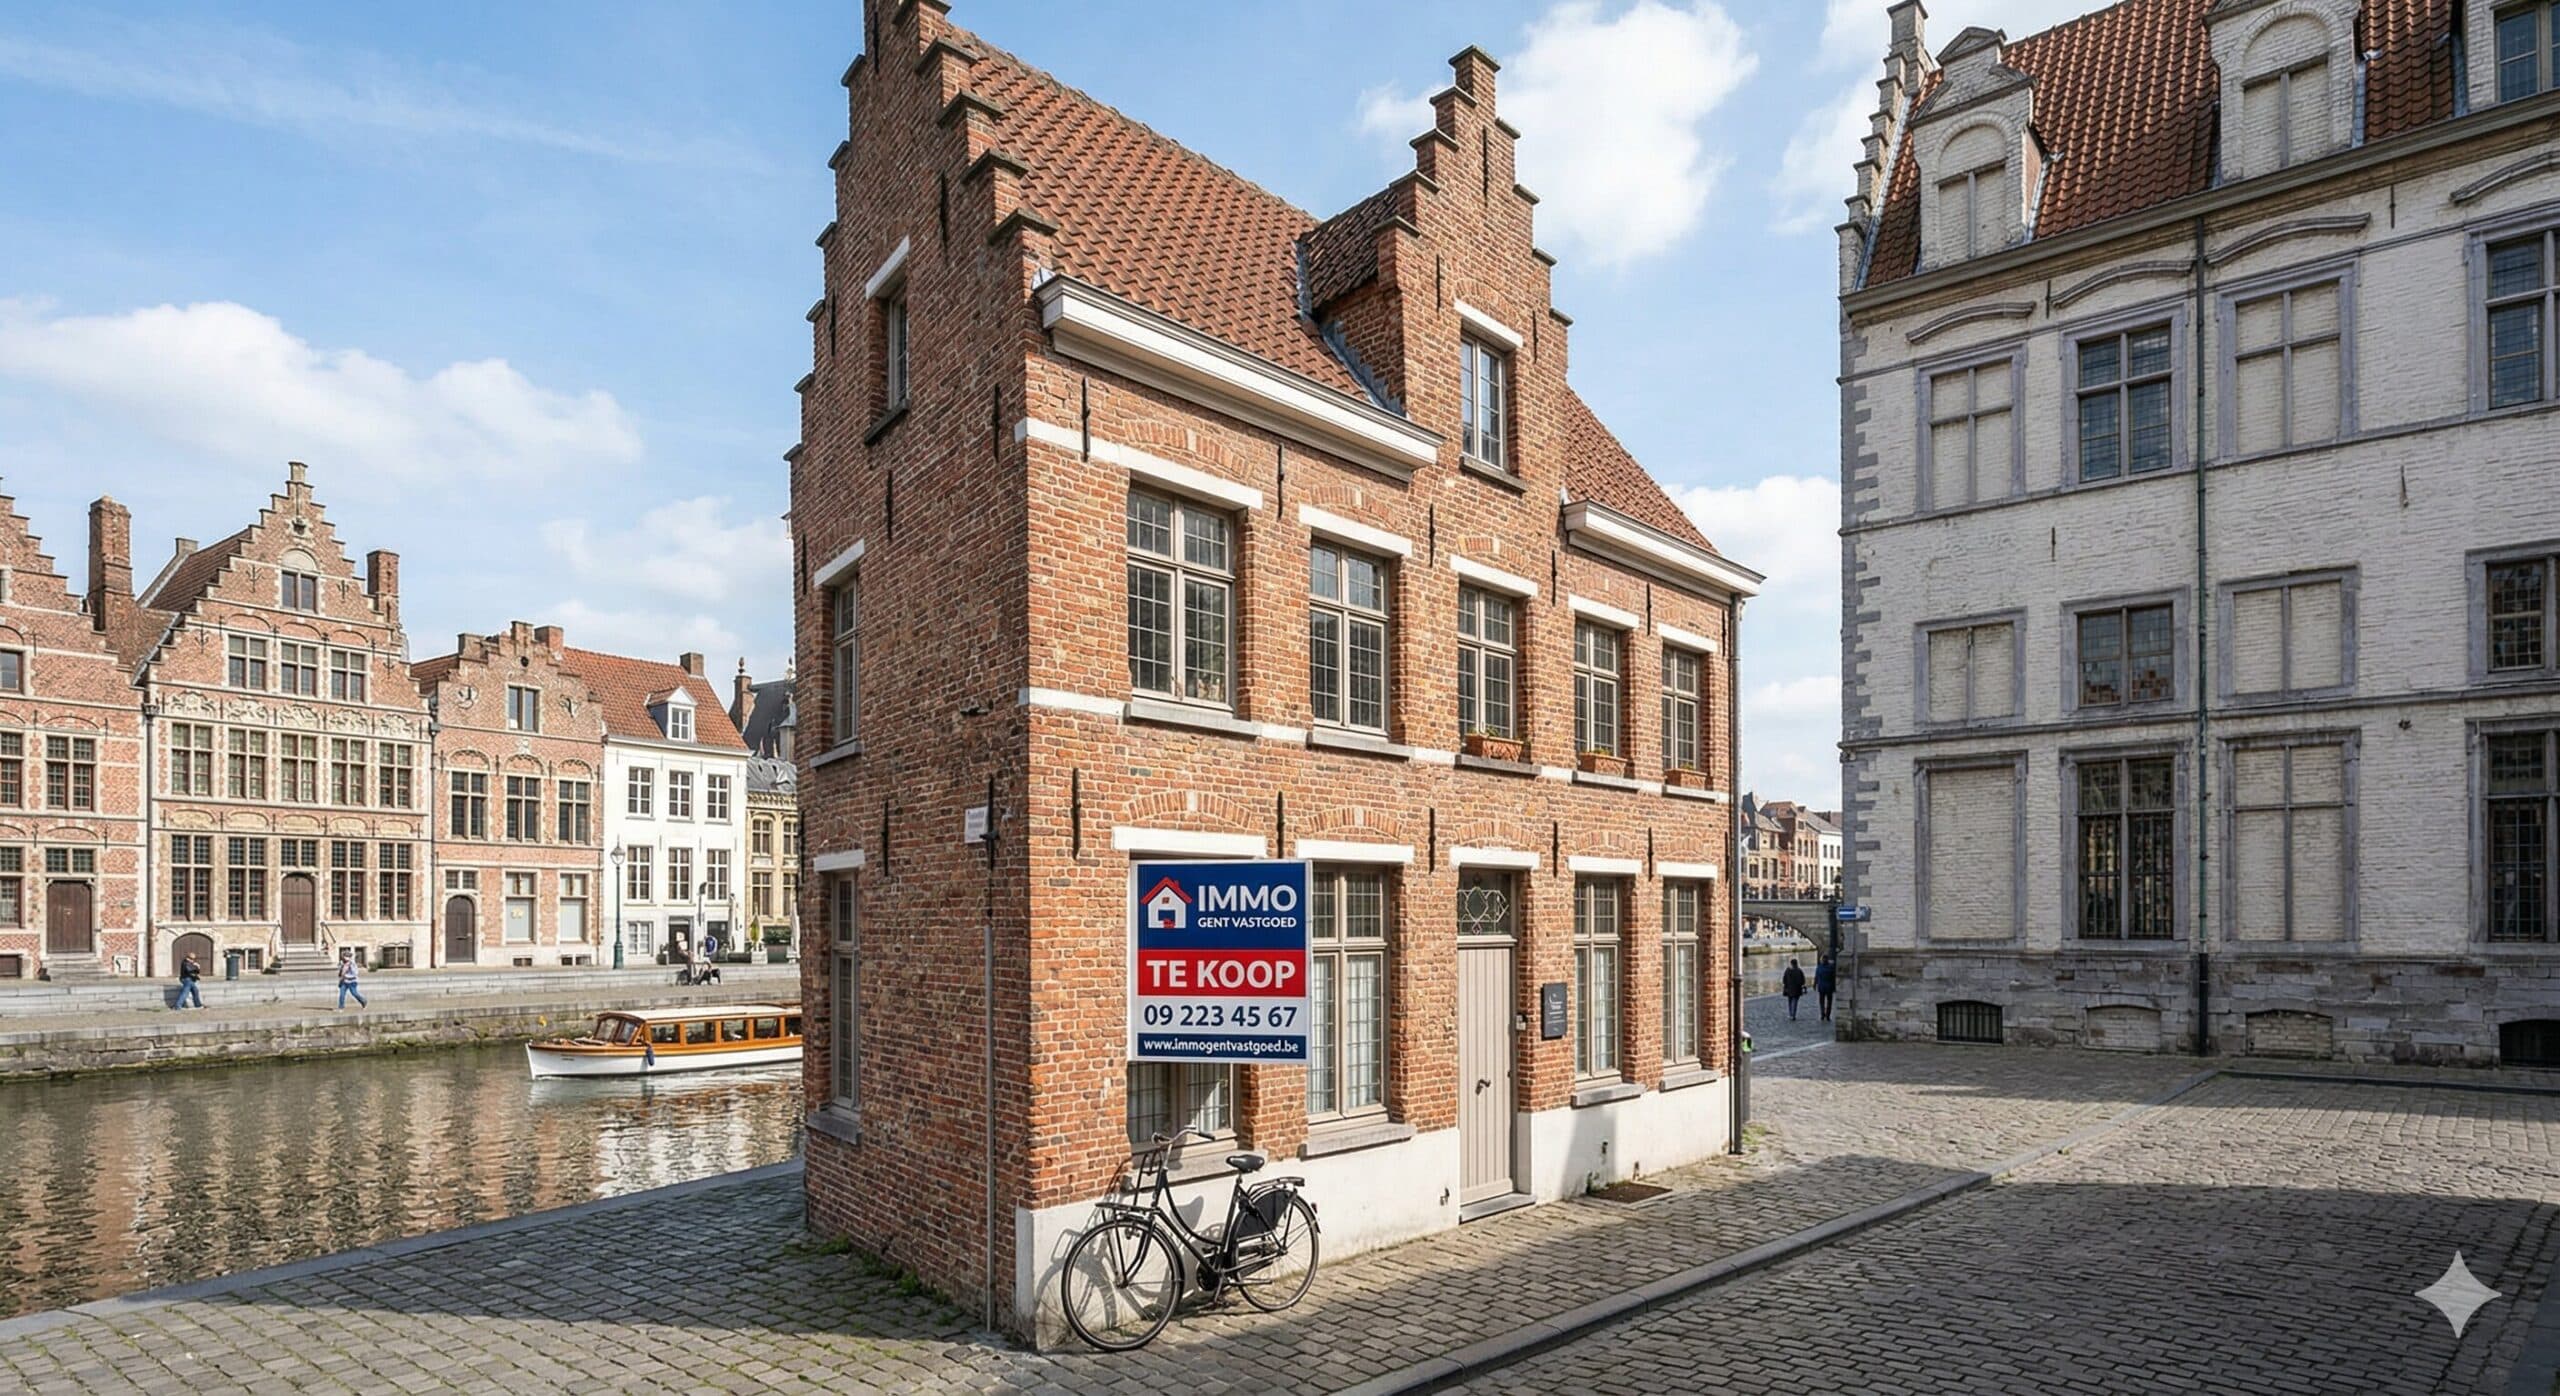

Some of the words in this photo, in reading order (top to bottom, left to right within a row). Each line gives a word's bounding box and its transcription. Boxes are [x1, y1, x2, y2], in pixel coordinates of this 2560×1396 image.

[1198, 885, 1297, 912] IMMO
[1197, 917, 1230, 928] GENT
[1232, 917, 1297, 928] VASTGOED
[1146, 960, 1187, 988] TE
[1197, 960, 1296, 989] KOOP
[1144, 1004, 1173, 1026] 09
[1180, 1005, 1224, 1027] 223
[1231, 1006, 1260, 1027] 45
[1268, 1006, 1297, 1027] 67
[1144, 1038, 1299, 1055] www.immogentvastgoed.be
